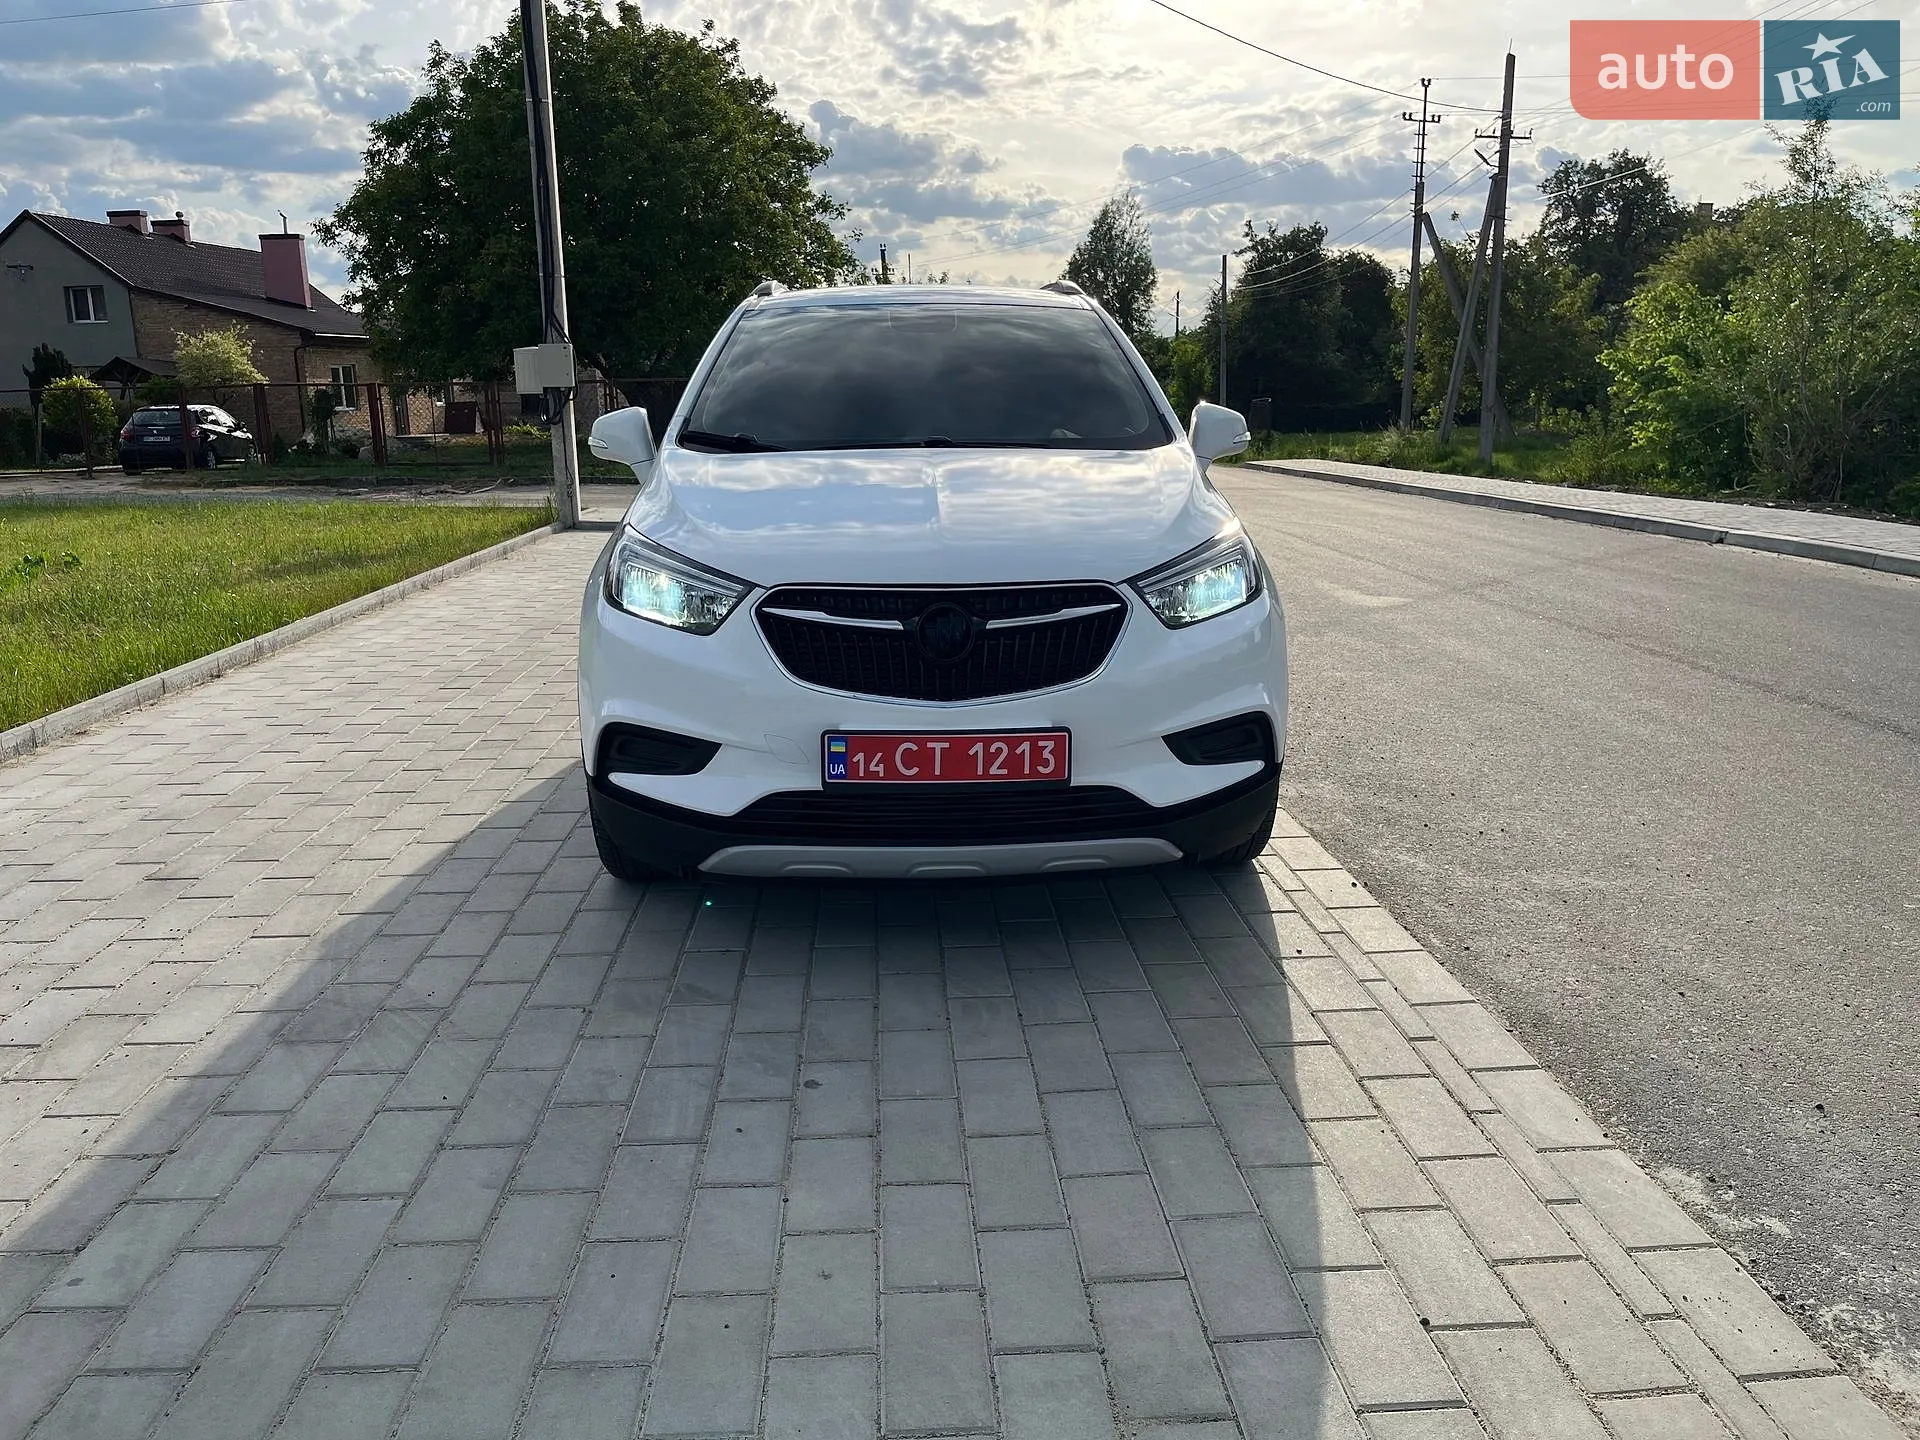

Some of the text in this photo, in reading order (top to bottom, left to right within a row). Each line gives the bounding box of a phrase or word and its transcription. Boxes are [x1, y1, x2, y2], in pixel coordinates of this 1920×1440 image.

[830, 763, 845, 775] UA
[852, 740, 1055, 777] 14 CT 1213
